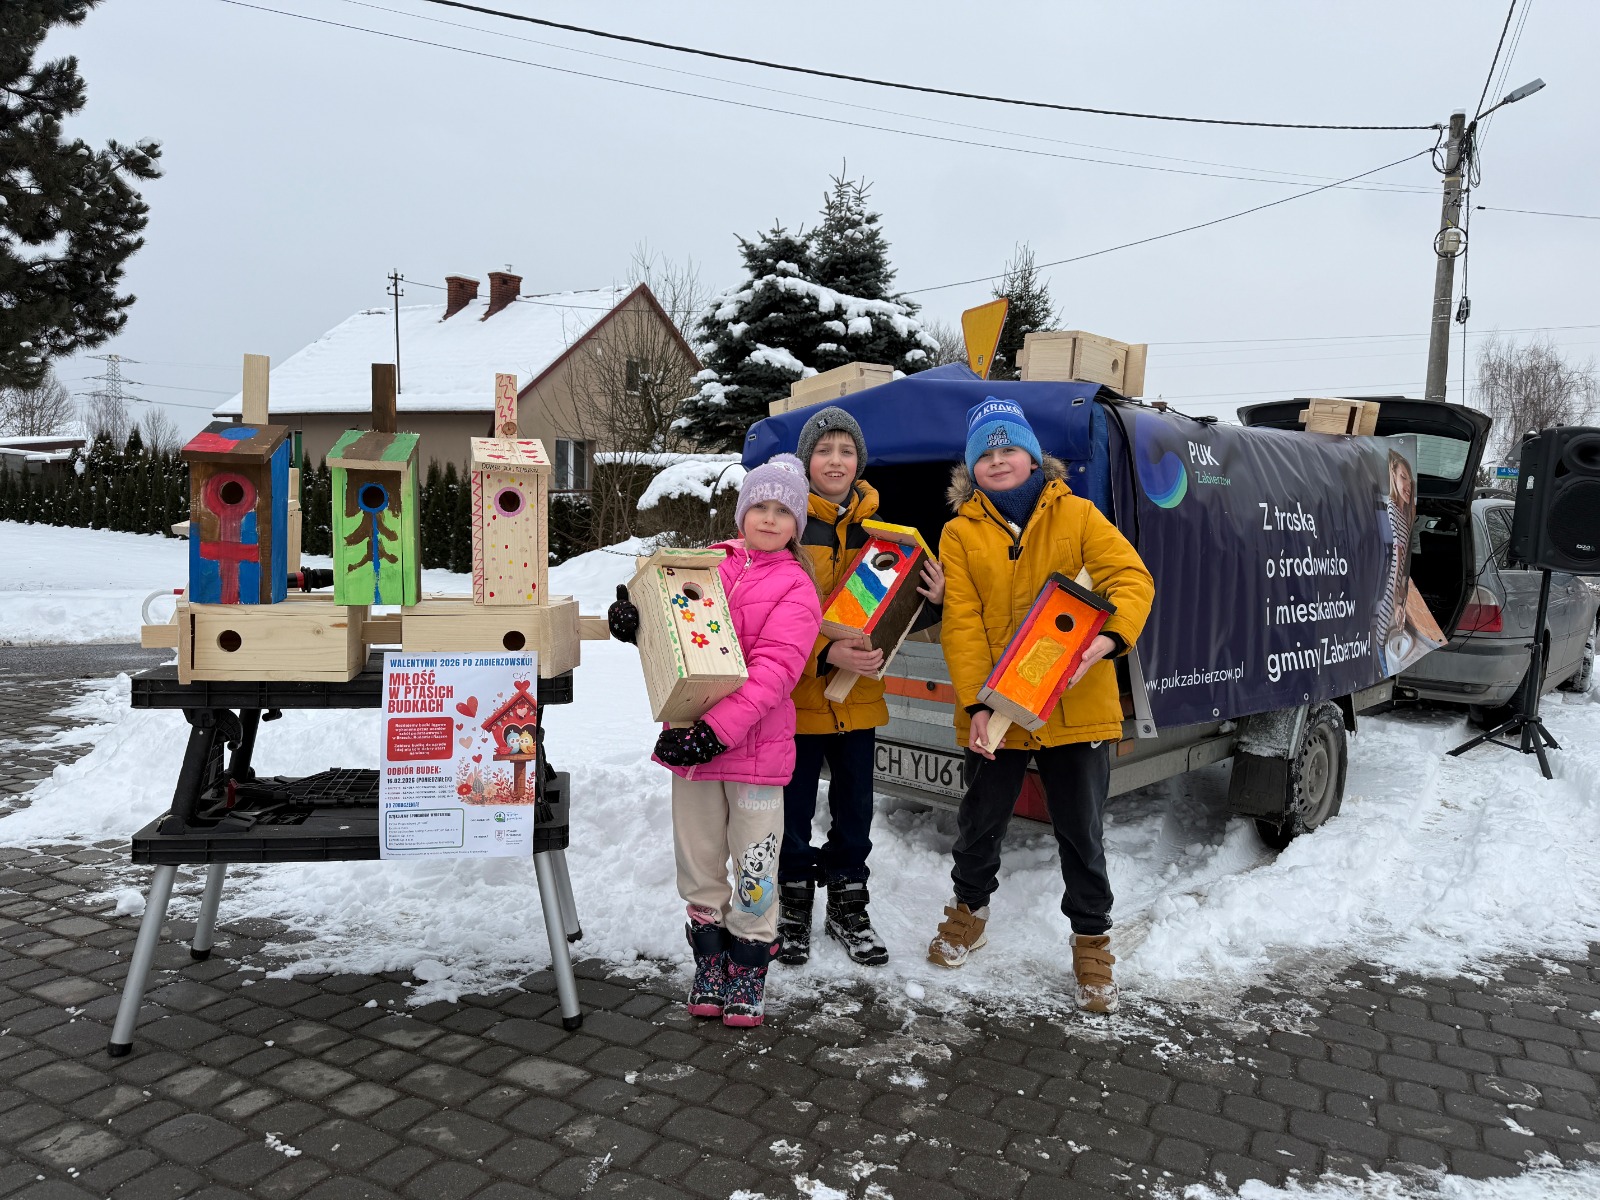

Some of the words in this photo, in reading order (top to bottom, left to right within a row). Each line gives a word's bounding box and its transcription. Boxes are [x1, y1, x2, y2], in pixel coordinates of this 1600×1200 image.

[983, 403, 1022, 416] KRAKÓ
[1188, 441, 1220, 466] PUK
[1259, 503, 1273, 531] Z
[1275, 502, 1318, 539] troską
[1266, 556, 1276, 578] o
[1266, 598, 1270, 626] i
[390, 658, 437, 668] WALENTYNKI
[440, 658, 460, 667] 2026
[463, 658, 473, 667] PO
[475, 657, 533, 667] ZABIERZOWSKU!
[1267, 641, 1321, 682] gminy
[1320, 631, 1372, 666] Zabierzów!
[389, 669, 436, 687] MIŁOŚĆ
[388, 686, 400, 700] W
[404, 685, 454, 699] PTASICH
[387, 699, 444, 713] BUDKACH
[387, 765, 414, 776] ODBIÓR
[416, 765, 442, 775] BUDEK:
[875, 745, 902, 776] CH
